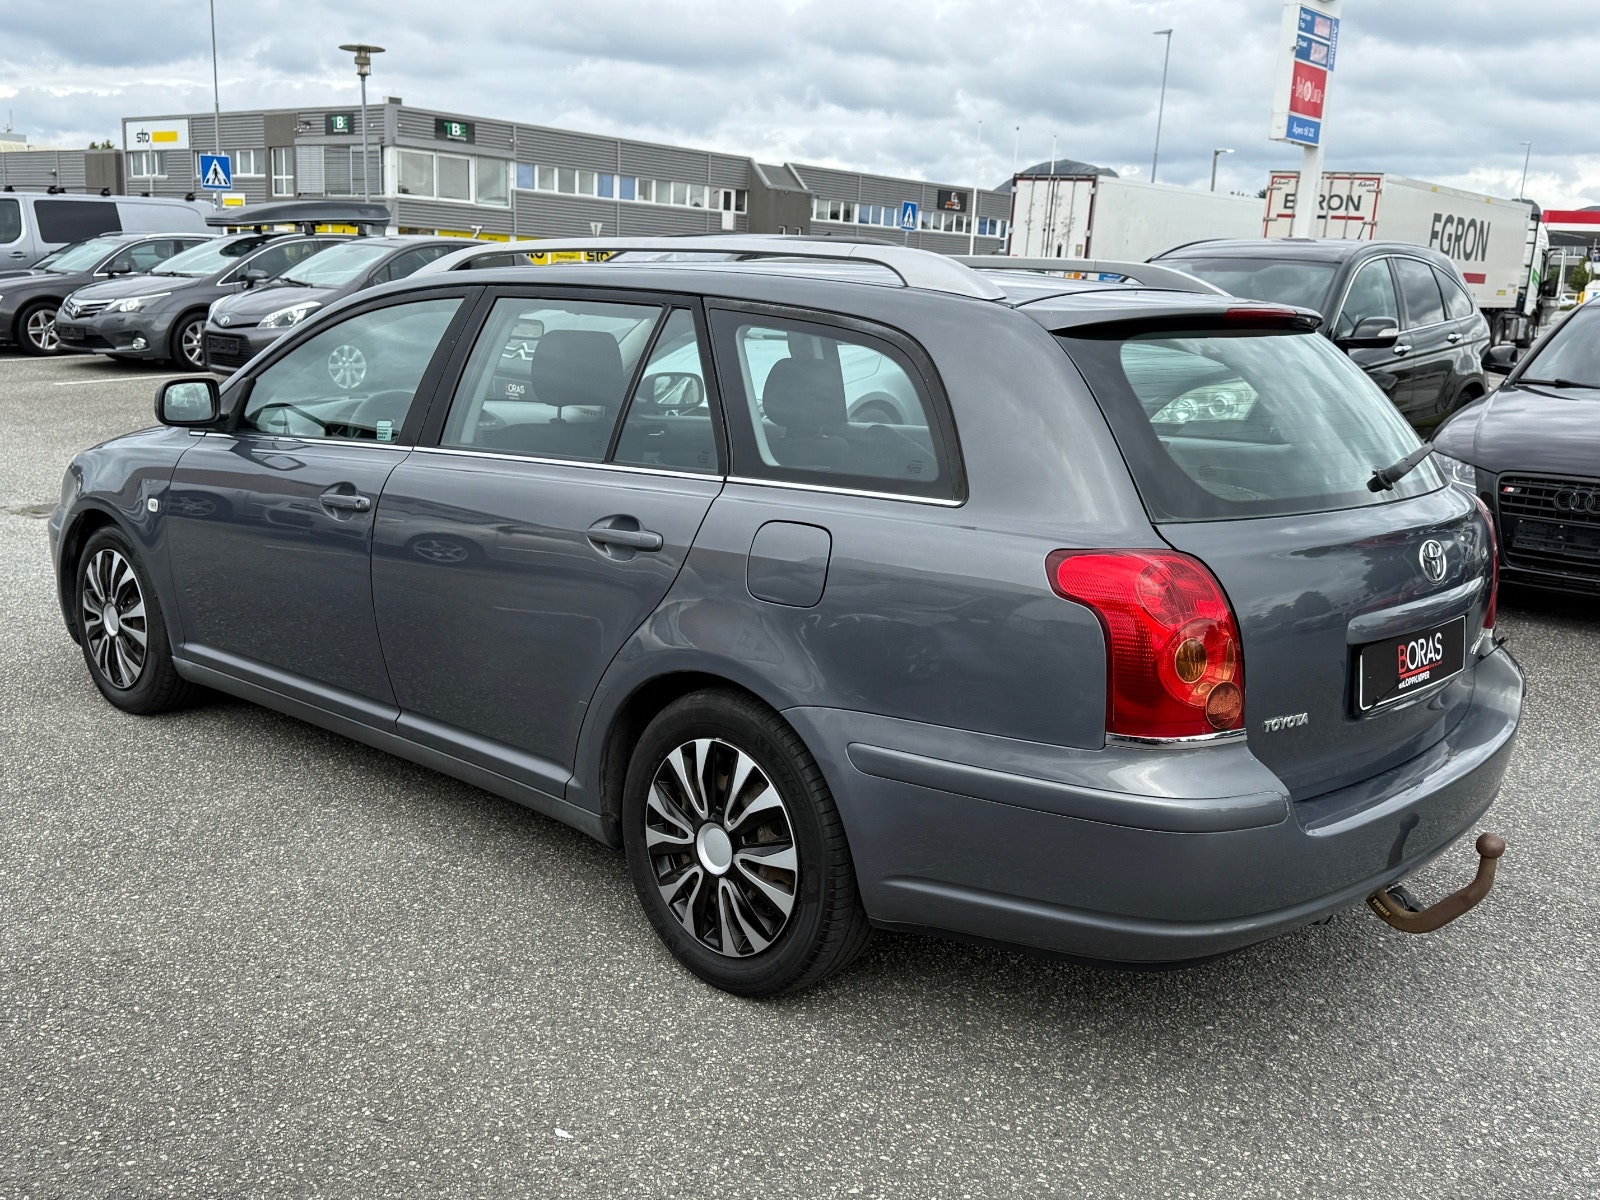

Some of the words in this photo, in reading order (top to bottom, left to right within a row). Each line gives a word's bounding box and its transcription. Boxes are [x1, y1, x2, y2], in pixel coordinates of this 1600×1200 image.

[331, 116, 348, 129] TBE
[444, 122, 467, 137] TBE
[136, 128, 150, 143] sto
[1283, 193, 1362, 212] ERON
[1397, 632, 1443, 674] BORAS
[1263, 712, 1309, 733] TOYOTA
[1372, 898, 1392, 918] THULE
